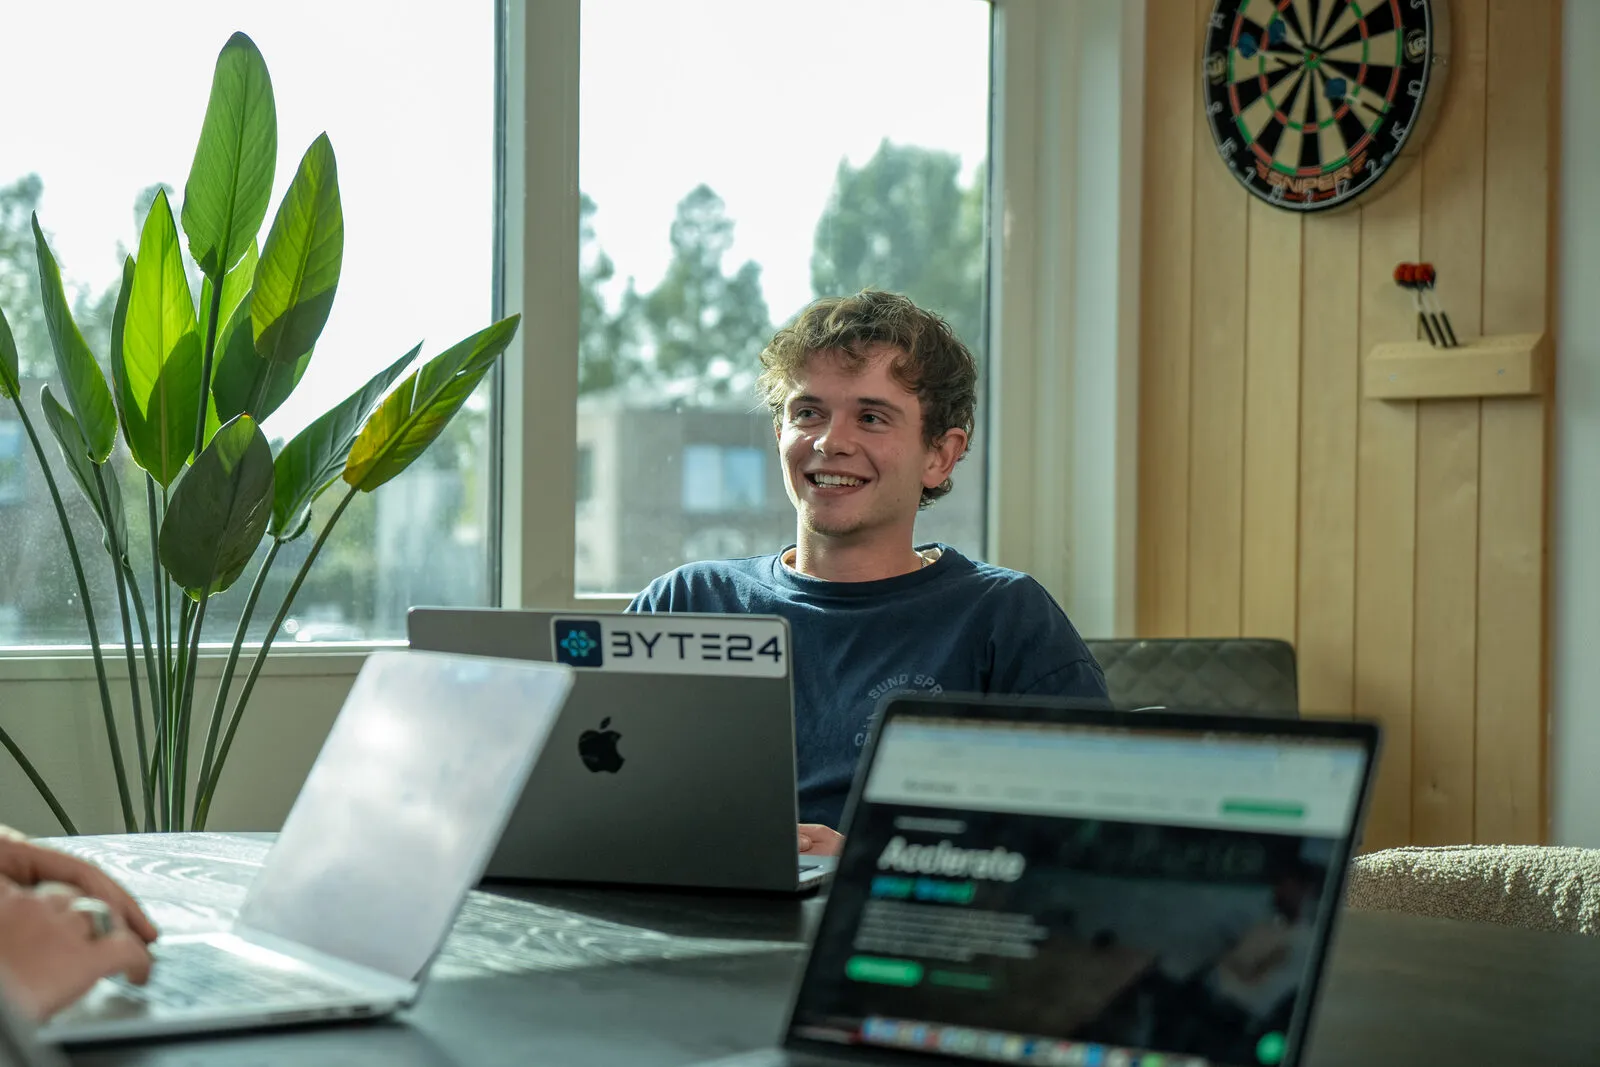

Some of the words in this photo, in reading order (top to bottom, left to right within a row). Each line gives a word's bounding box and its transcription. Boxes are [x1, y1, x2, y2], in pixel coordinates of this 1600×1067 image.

[611, 631, 782, 663] BYTE24
[913, 674, 943, 697] SPR
[854, 732, 872, 747] CA
